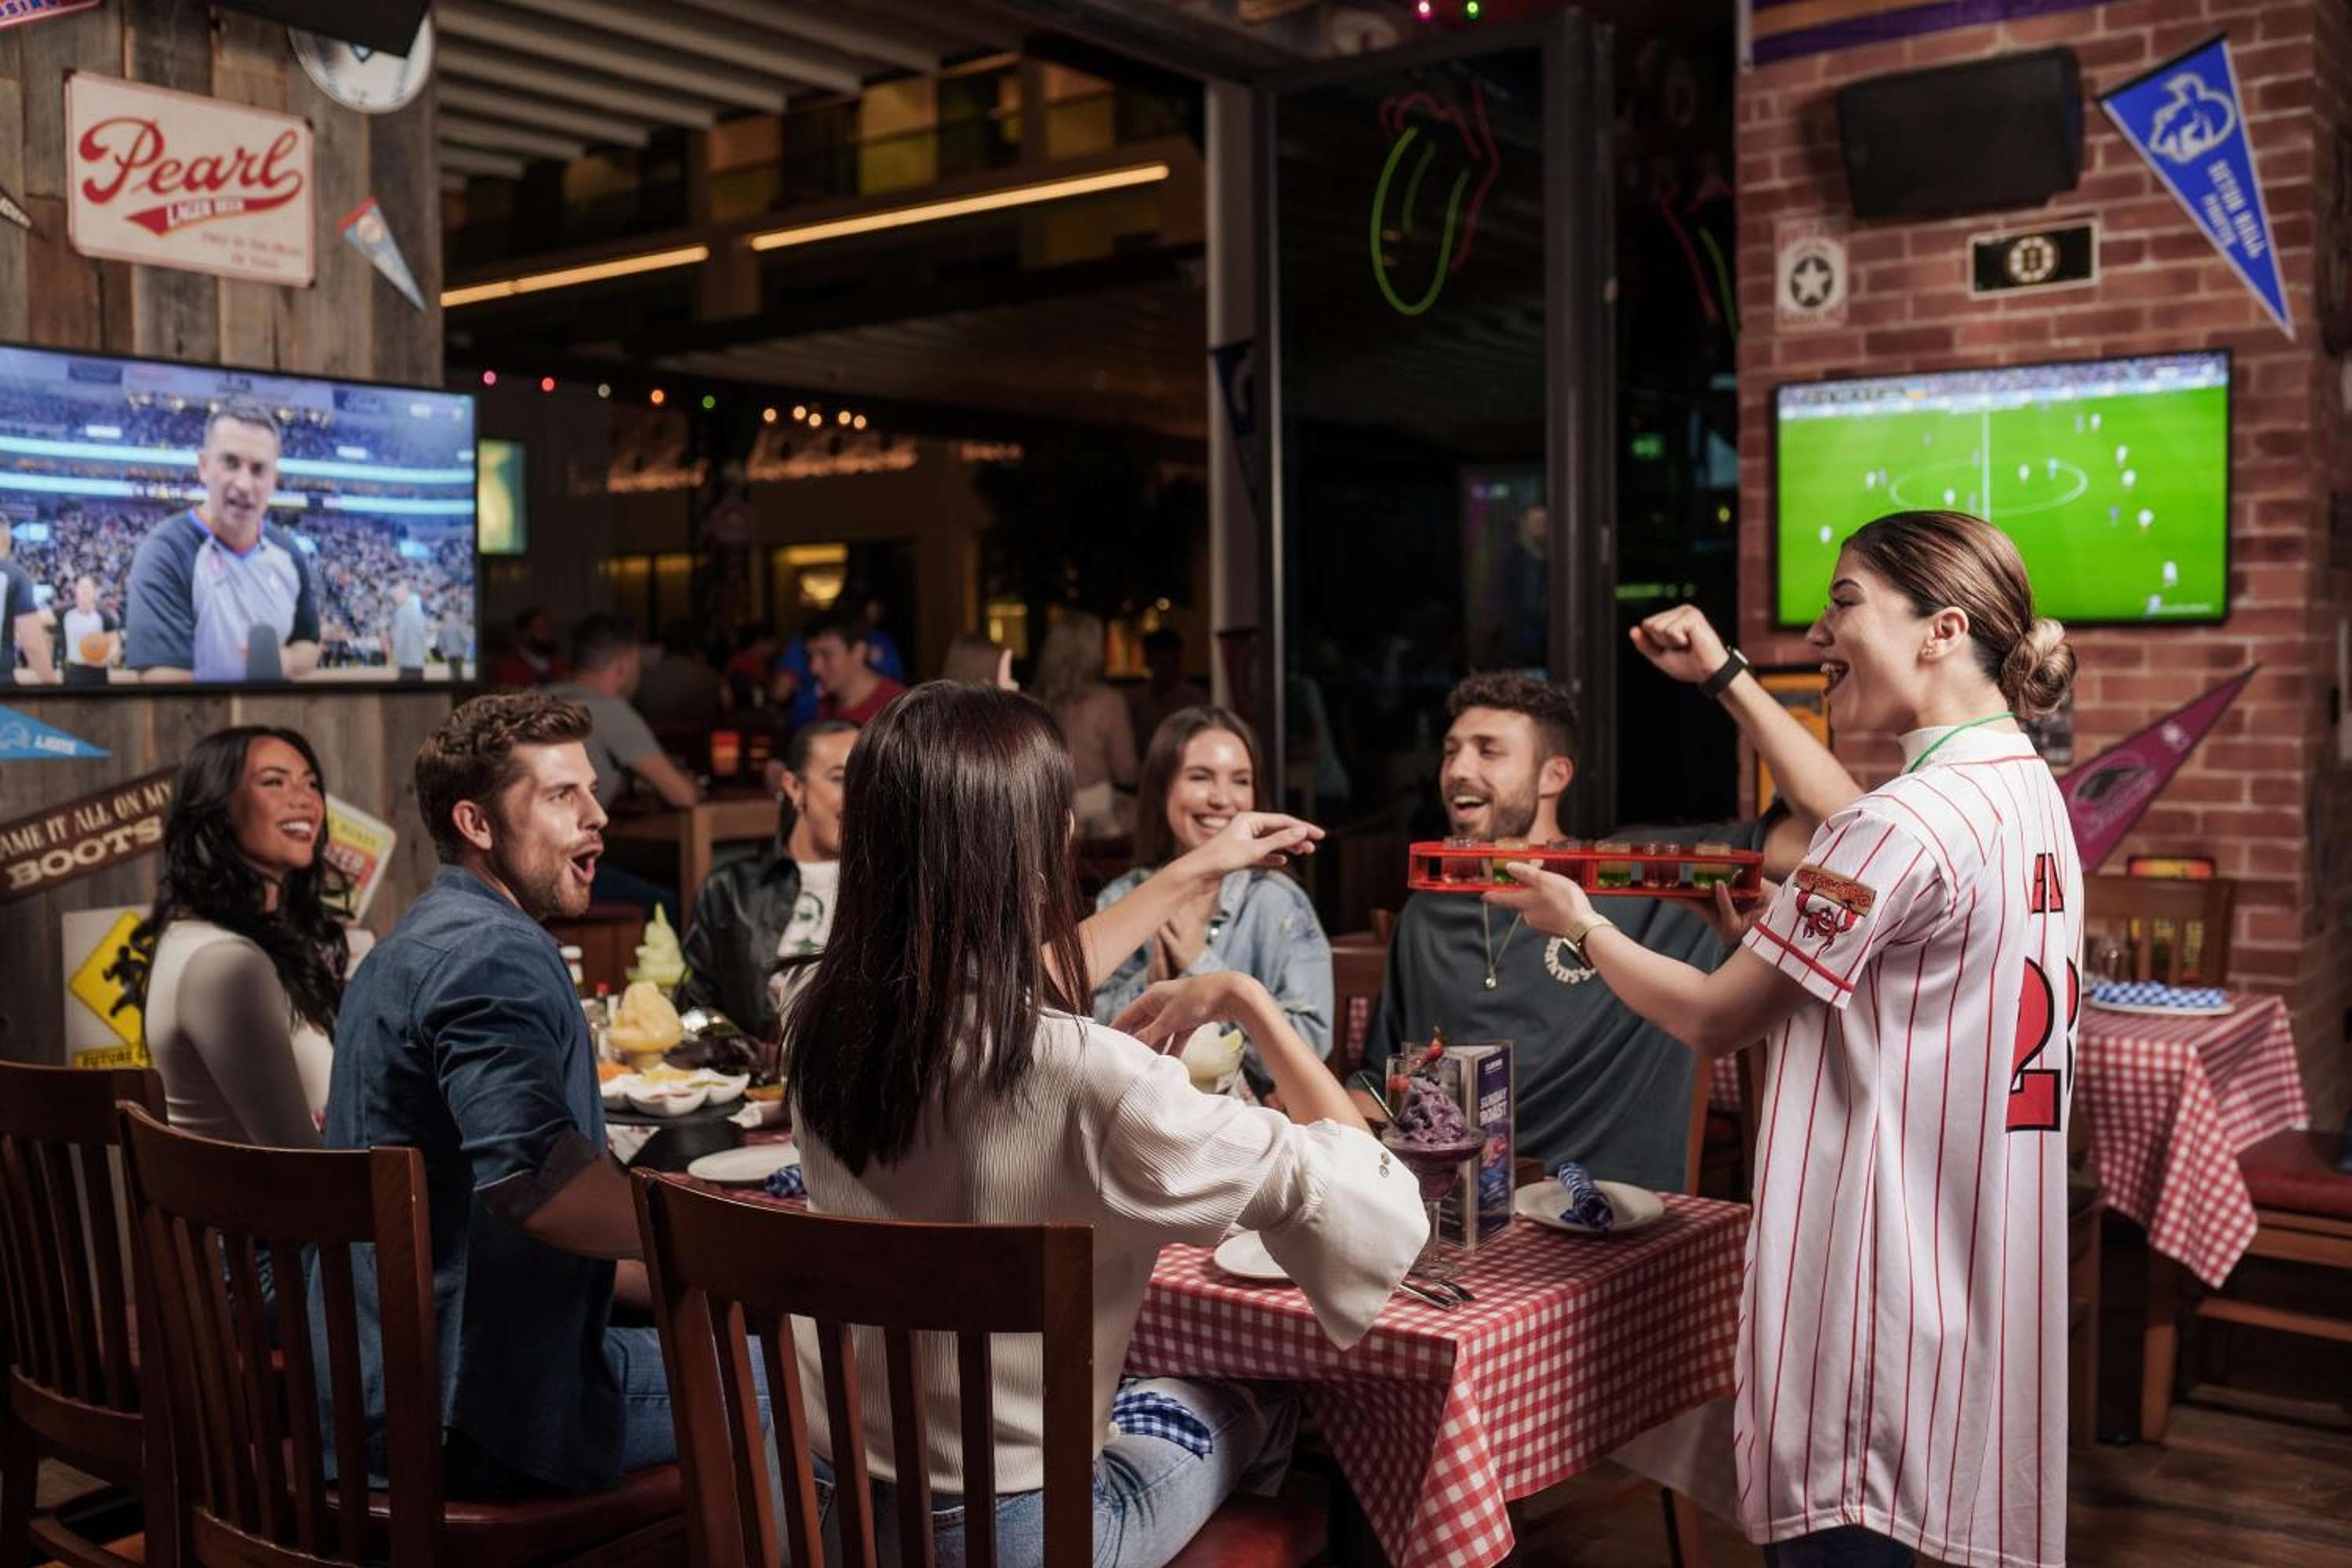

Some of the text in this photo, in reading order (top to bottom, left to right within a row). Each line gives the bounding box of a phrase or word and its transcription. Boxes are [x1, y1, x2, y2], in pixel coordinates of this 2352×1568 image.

[79, 116, 304, 207] Pearl
[45, 814, 67, 844] IT
[74, 801, 113, 835] ALL
[113, 790, 144, 820] ON
[6, 814, 163, 891] BOOTS
[1479, 1100, 1508, 1127] ROAST
